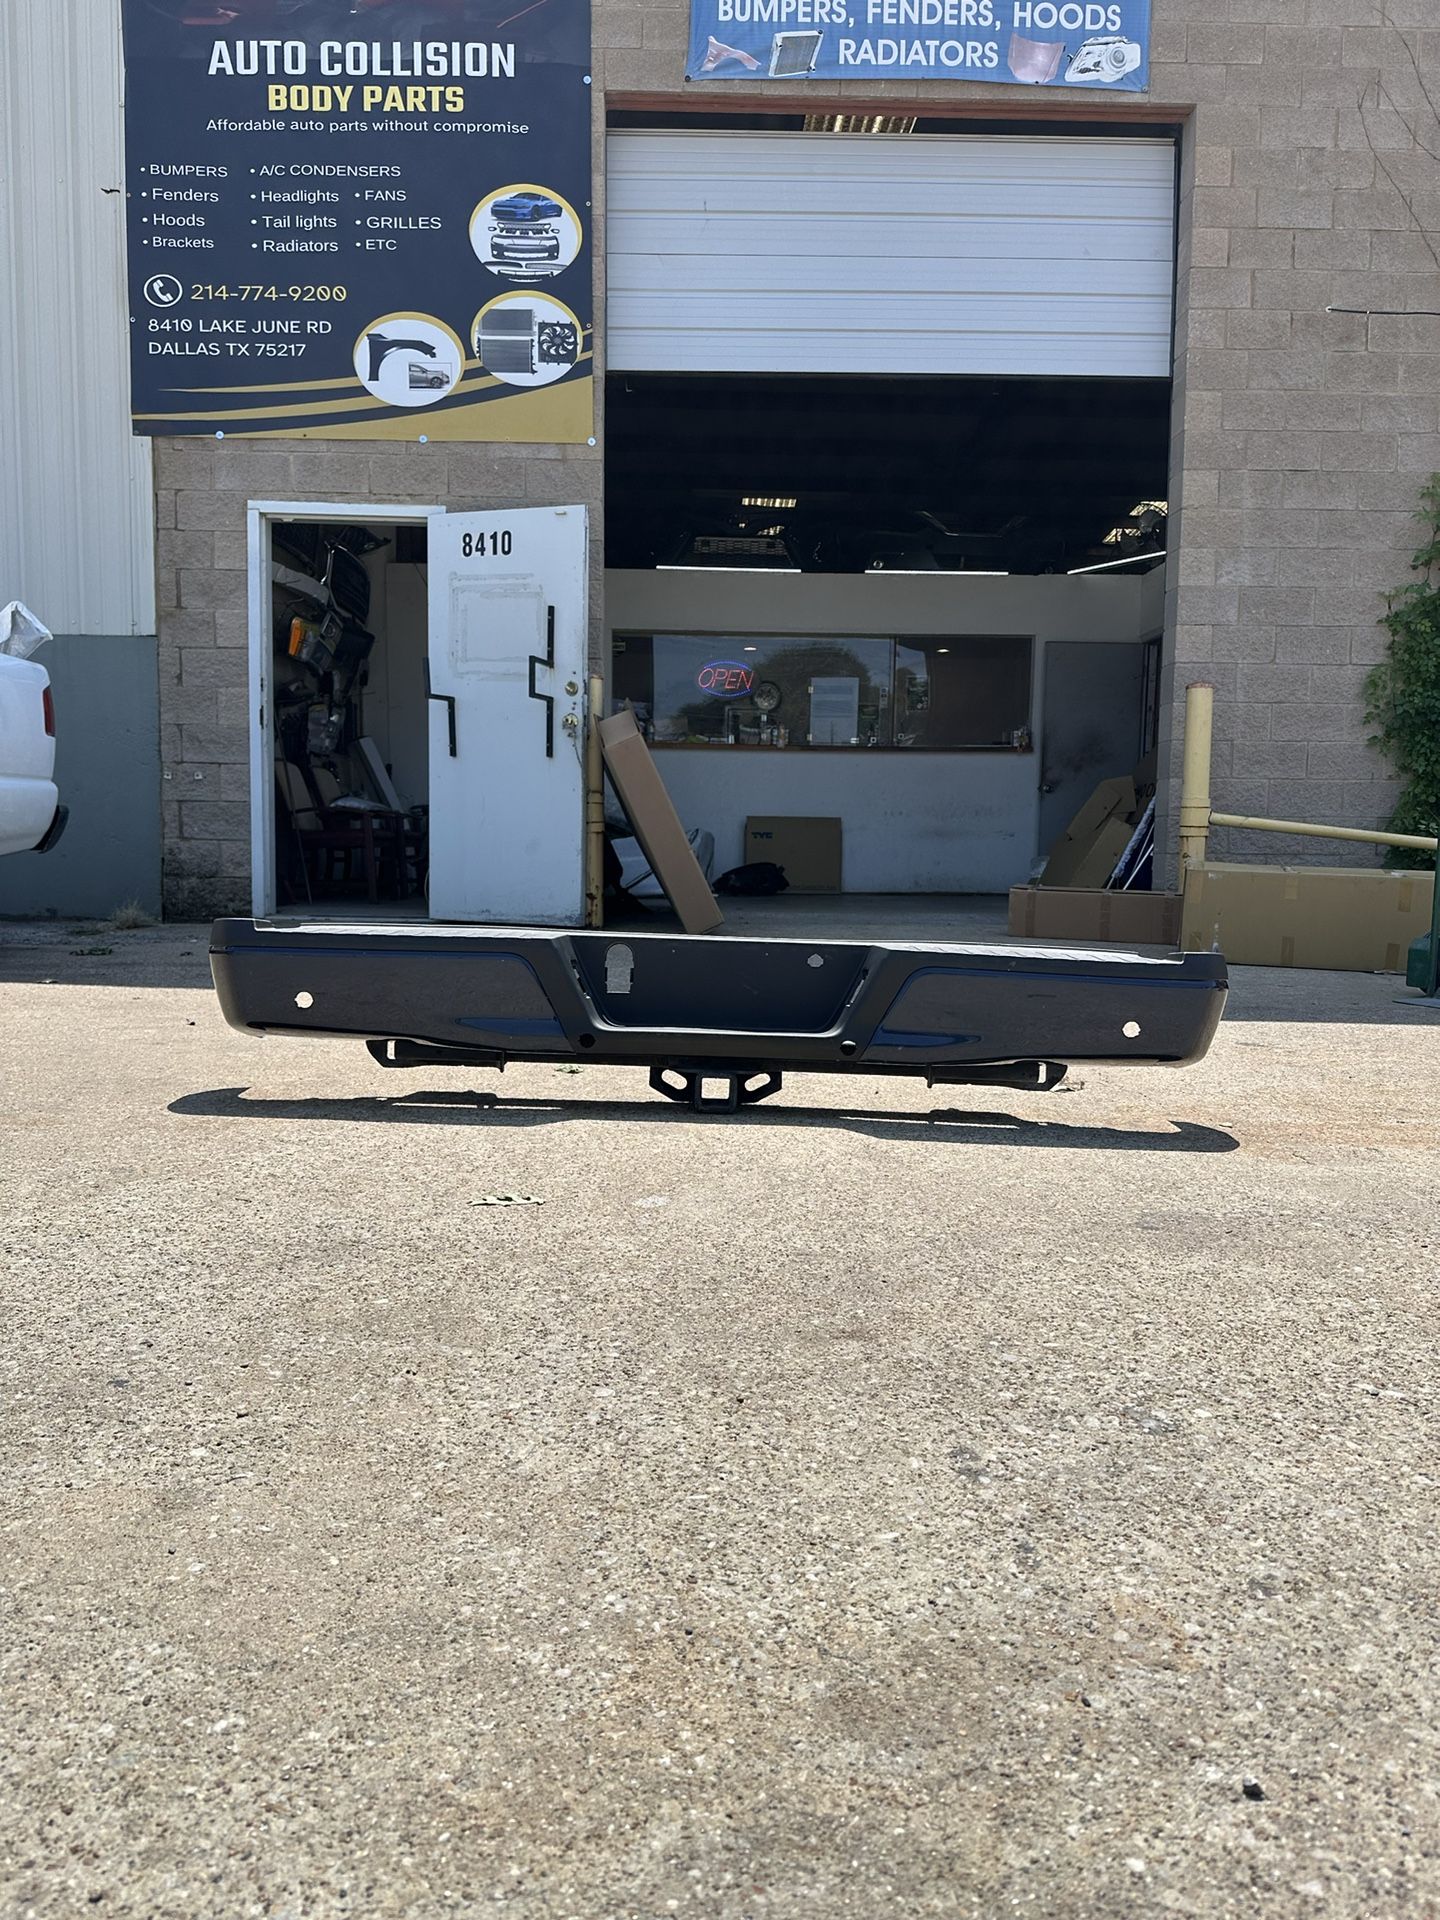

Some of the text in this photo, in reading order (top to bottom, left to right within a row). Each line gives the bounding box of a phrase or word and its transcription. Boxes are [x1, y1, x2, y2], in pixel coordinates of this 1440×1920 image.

[718, 0, 1122, 32] BUMPERS, FENDERS, HOODS
[207, 40, 515, 78] AUTO COLLISION
[838, 38, 999, 68] RADIATORS
[268, 84, 464, 113] BODY PARTS
[206, 118, 530, 135] Affordable auto parts without compromise
[149, 164, 228, 178] BUMPERS
[259, 164, 401, 177] A/C CONDENSERS
[152, 187, 219, 203] Fenders
[261, 189, 340, 205] Headlights
[364, 189, 407, 202] FANS
[153, 213, 206, 227] Hoods
[261, 215, 338, 231] Tail lights
[366, 216, 442, 230] GRILLES
[152, 236, 215, 249] Brackets
[263, 239, 339, 253] Radiators
[365, 238, 397, 251] ETC
[190, 284, 347, 302] 214-774-9200
[148, 318, 332, 334] 8410 LAKE JUNE RD
[148, 341, 307, 357] DALLAS TX 75217
[462, 530, 512, 557] 8410
[698, 667, 755, 691] OPEN
